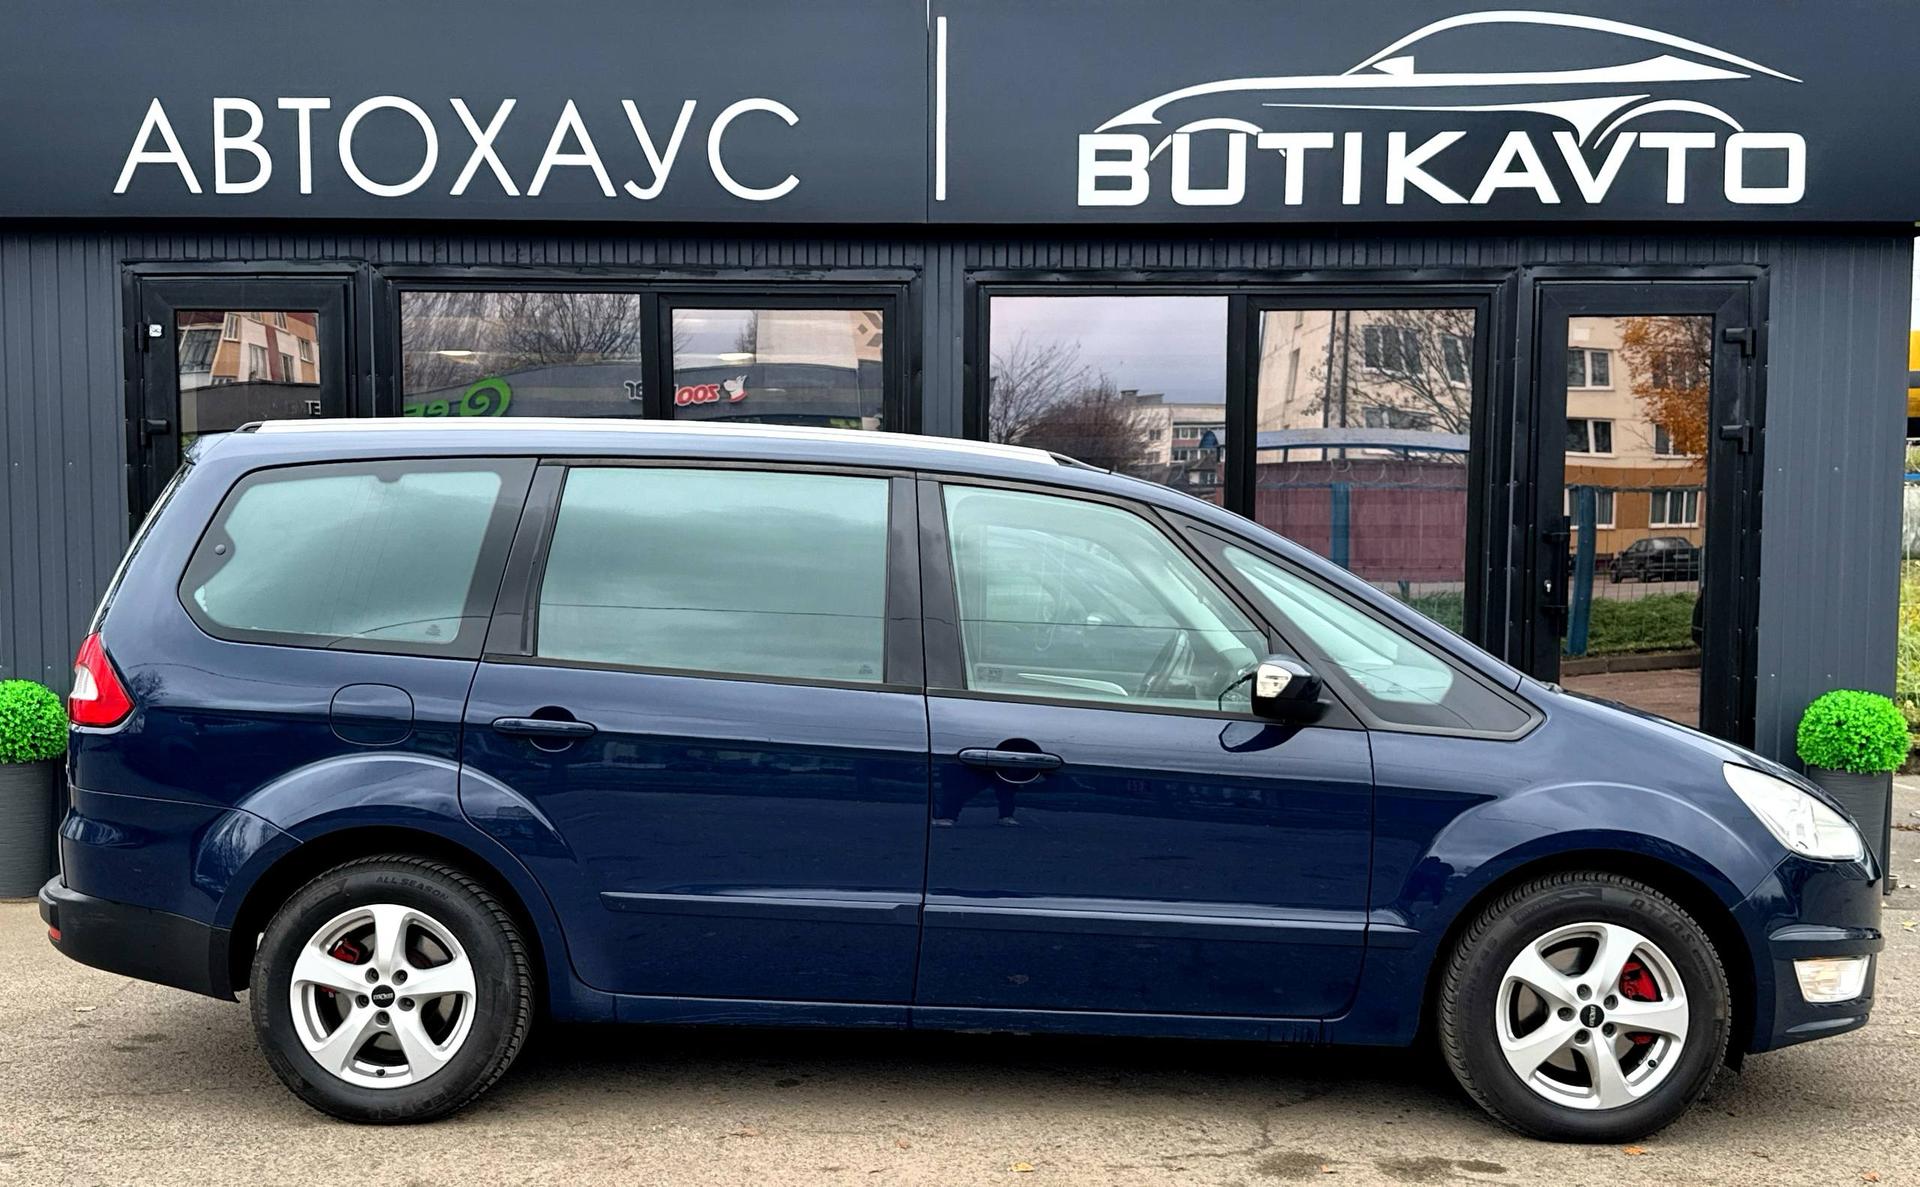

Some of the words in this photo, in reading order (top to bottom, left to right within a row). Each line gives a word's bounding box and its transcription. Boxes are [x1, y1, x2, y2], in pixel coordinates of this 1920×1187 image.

[113, 95, 800, 201] АВТОХАУС
[1077, 132, 1807, 206] BUTIKAVTO
[376, 876, 398, 885] ALL
[401, 878, 450, 901] SEASON
